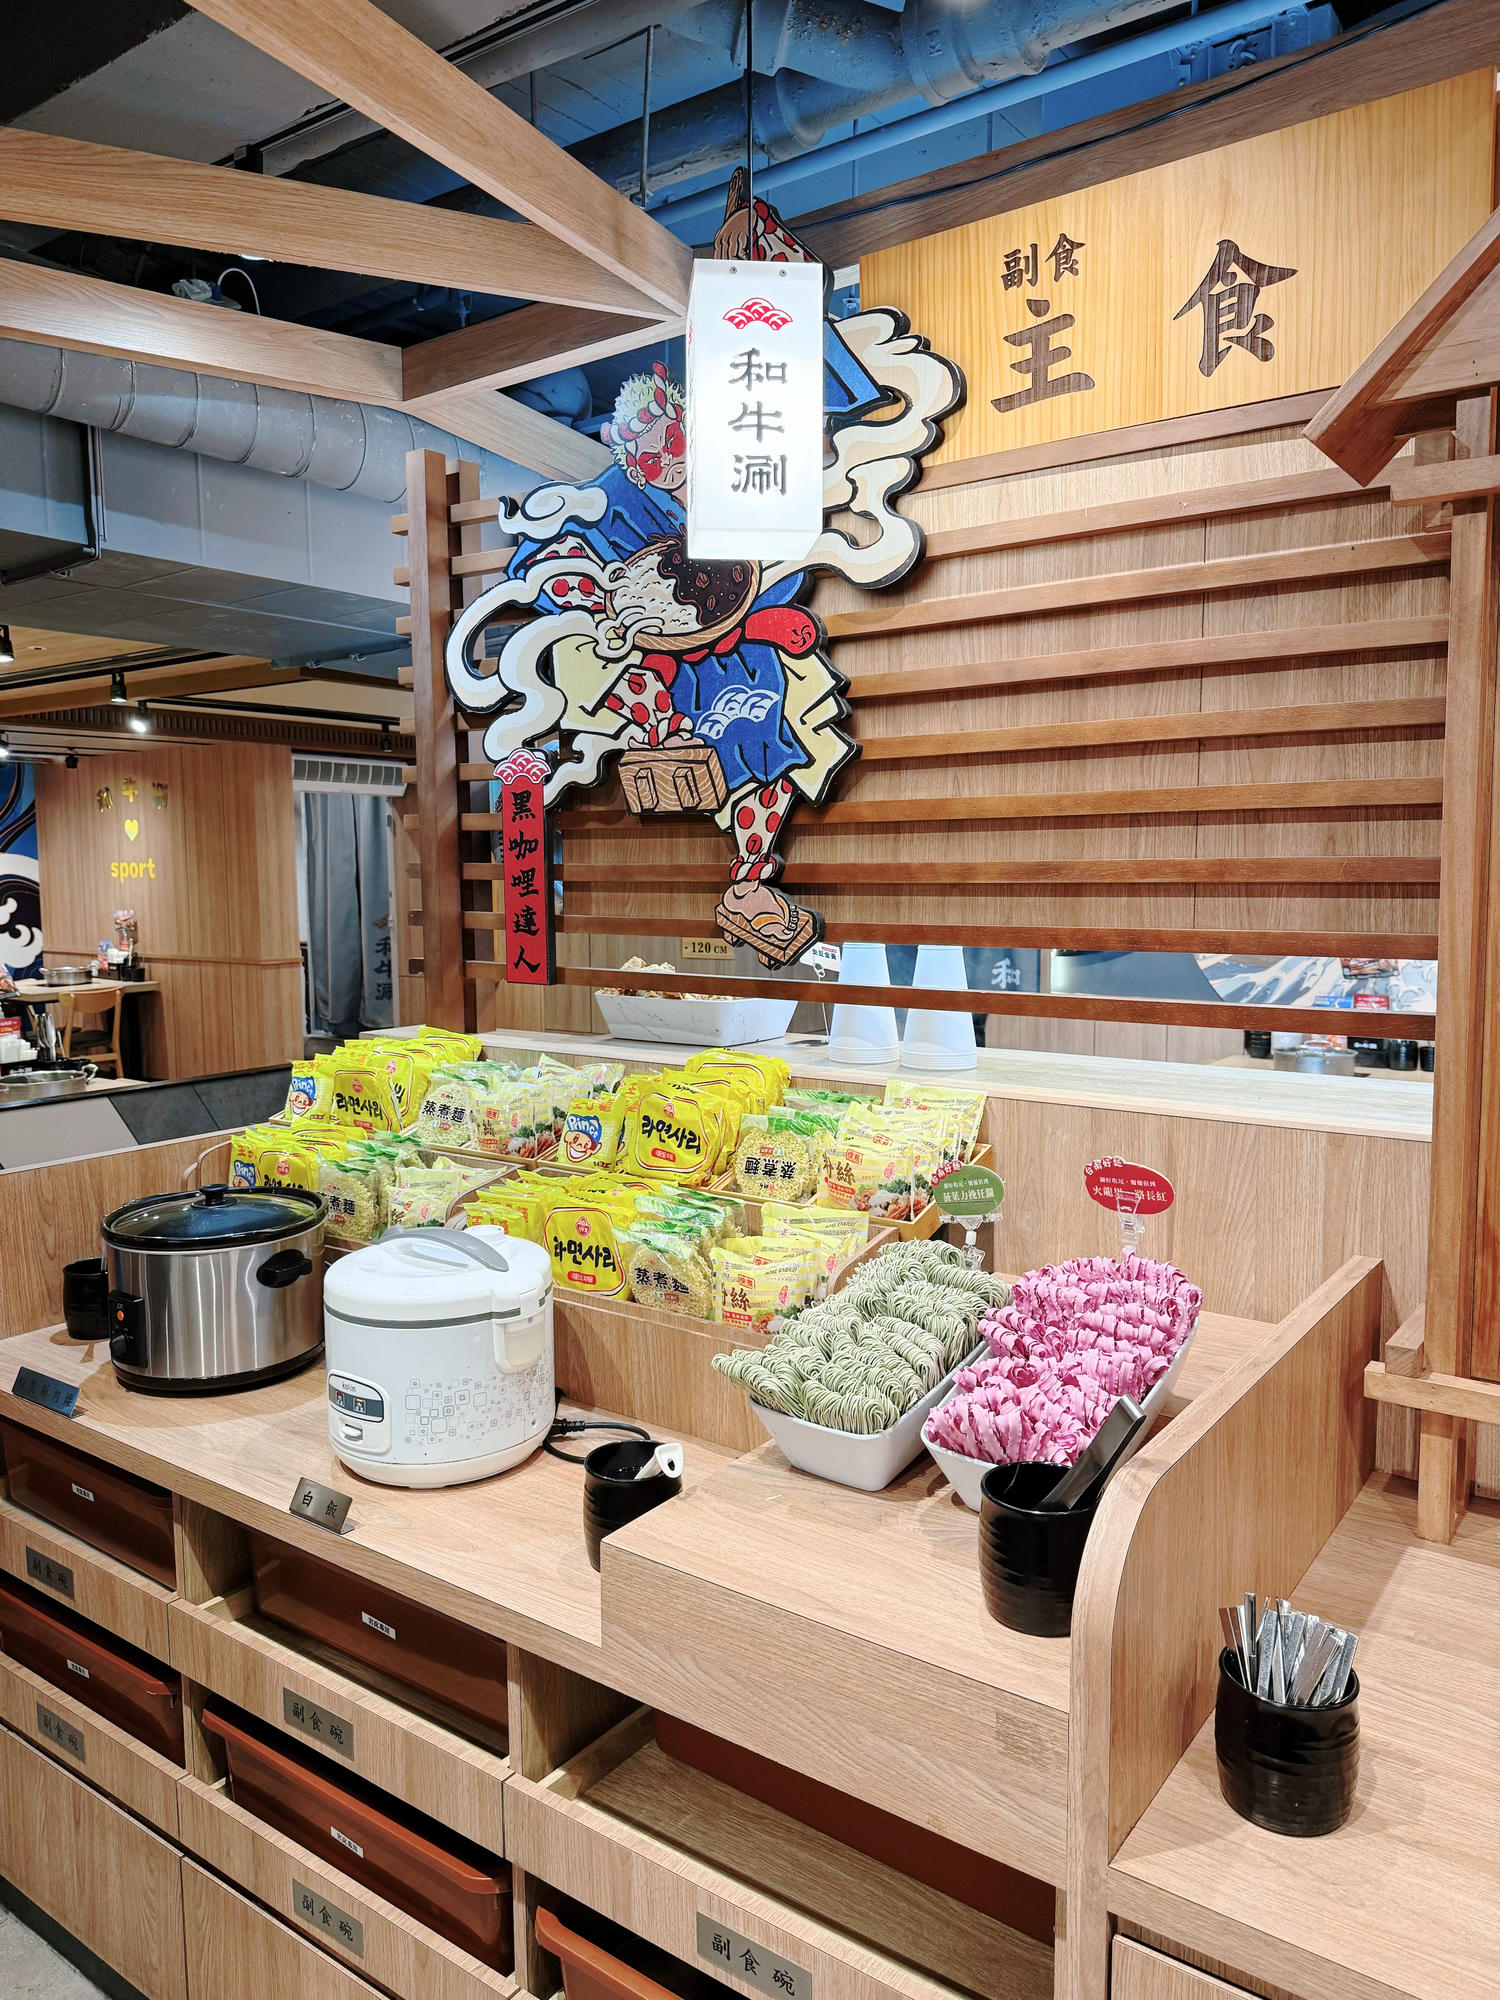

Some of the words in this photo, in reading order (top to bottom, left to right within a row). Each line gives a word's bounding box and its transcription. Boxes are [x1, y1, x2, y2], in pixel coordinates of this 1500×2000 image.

[1001, 233, 1086, 291] 副食
[991, 239, 1298, 413] 主食
[728, 347, 788, 496] 和牛涮
[110, 858, 155, 883] sport
[508, 789, 541, 974] 黑咖哩達人
[692, 942, 711, 954] 120
[714, 946, 728, 954] CM
[991, 958, 1020, 989] 和
[422, 1100, 466, 1123] 蒸煮麵
[568, 1115, 599, 1138] Prince
[641, 1115, 701, 1154] 라면사리
[744, 1156, 796, 1180] 蒸煮麵
[317, 1191, 355, 1216] 煮麵
[1092, 1185, 1168, 1202] 火龍果路長紅
[634, 1267, 689, 1294] 蒸煮麵
[302, 1491, 338, 1518] 白飯
[44, 1714, 79, 1751] 副食碗
[292, 1702, 344, 1745] 副食碗
[302, 1894, 354, 1942] 副食碗
[712, 1933, 796, 1997] 副食碗
